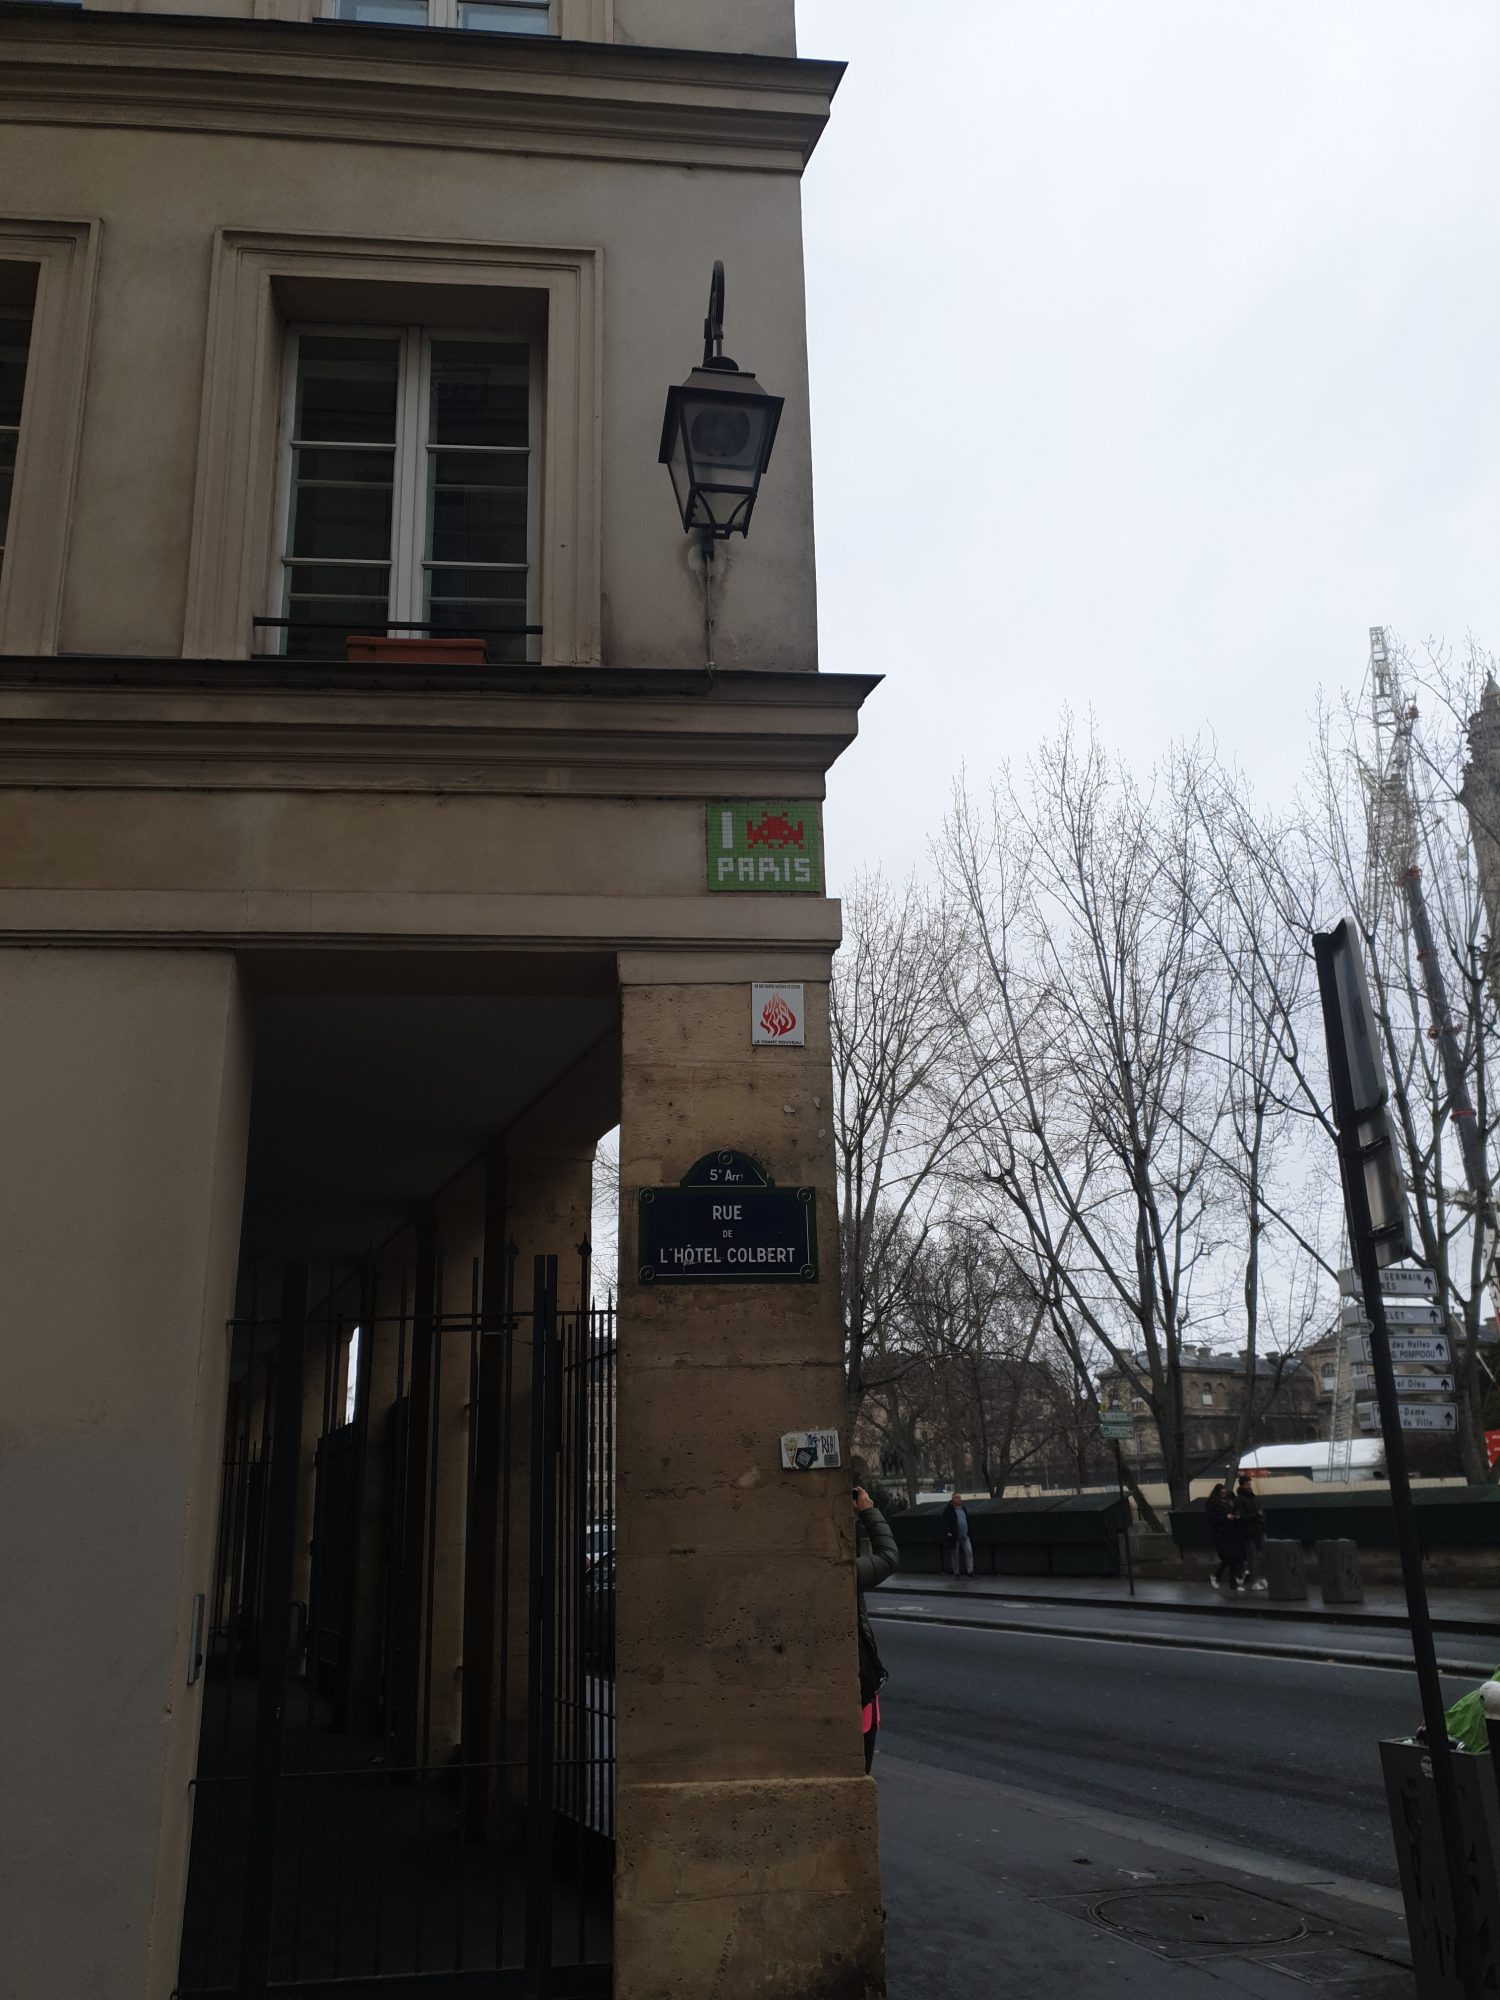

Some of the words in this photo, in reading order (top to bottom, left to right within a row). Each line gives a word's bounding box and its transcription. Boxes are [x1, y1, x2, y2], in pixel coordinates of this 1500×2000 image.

[721, 811, 733, 849] I
[717, 857, 811, 882] PARIS
[712, 1205, 742, 1220] RUE
[722, 1229, 733, 1238] DE
[727, 1248, 795, 1263] COLBERT
[1384, 1272, 1422, 1281] GERMAIN
[1391, 1341, 1404, 1349] des
[1407, 1341, 1431, 1349] Halles
[1400, 1351, 1435, 1359] POMPIDOU
[1407, 1380, 1426, 1388] Dieu
[1403, 1419, 1412, 1427] de
[1415, 1418, 1434, 1427] Ville
